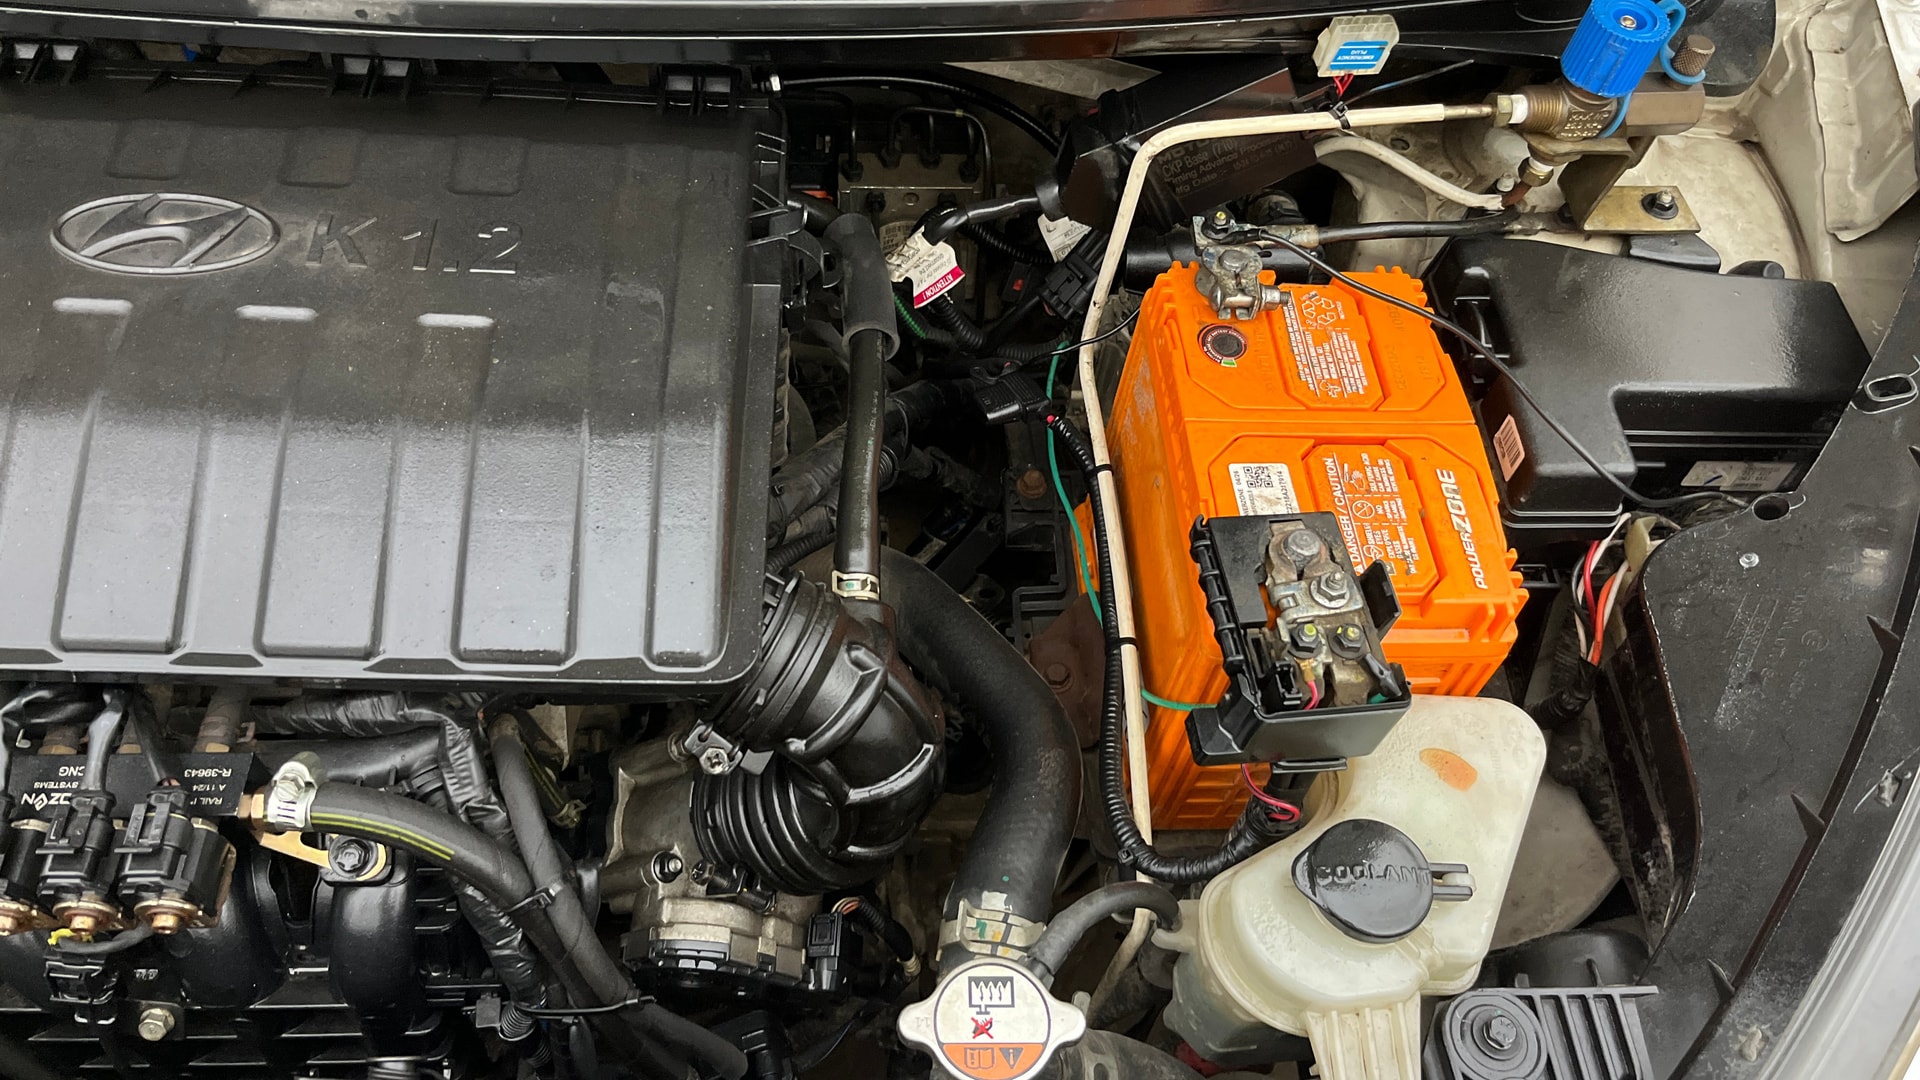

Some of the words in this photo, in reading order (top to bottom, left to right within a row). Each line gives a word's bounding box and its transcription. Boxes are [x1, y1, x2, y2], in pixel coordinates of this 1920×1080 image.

[305, 213, 378, 268] K
[402, 218, 523, 275] 1.2
[924, 274, 955, 297] ATTENTION
[1324, 458, 1345, 505] CAUTION
[1376, 505, 1384, 514] NO
[1339, 516, 1361, 561] DANGER
[1372, 530, 1383, 544] EYES
[184, 768, 232, 778] R-39643
[34, 781, 79, 789] SYSTEMS
[203, 797, 223, 805] RAIL
[1315, 862, 1430, 885] COOLANT
